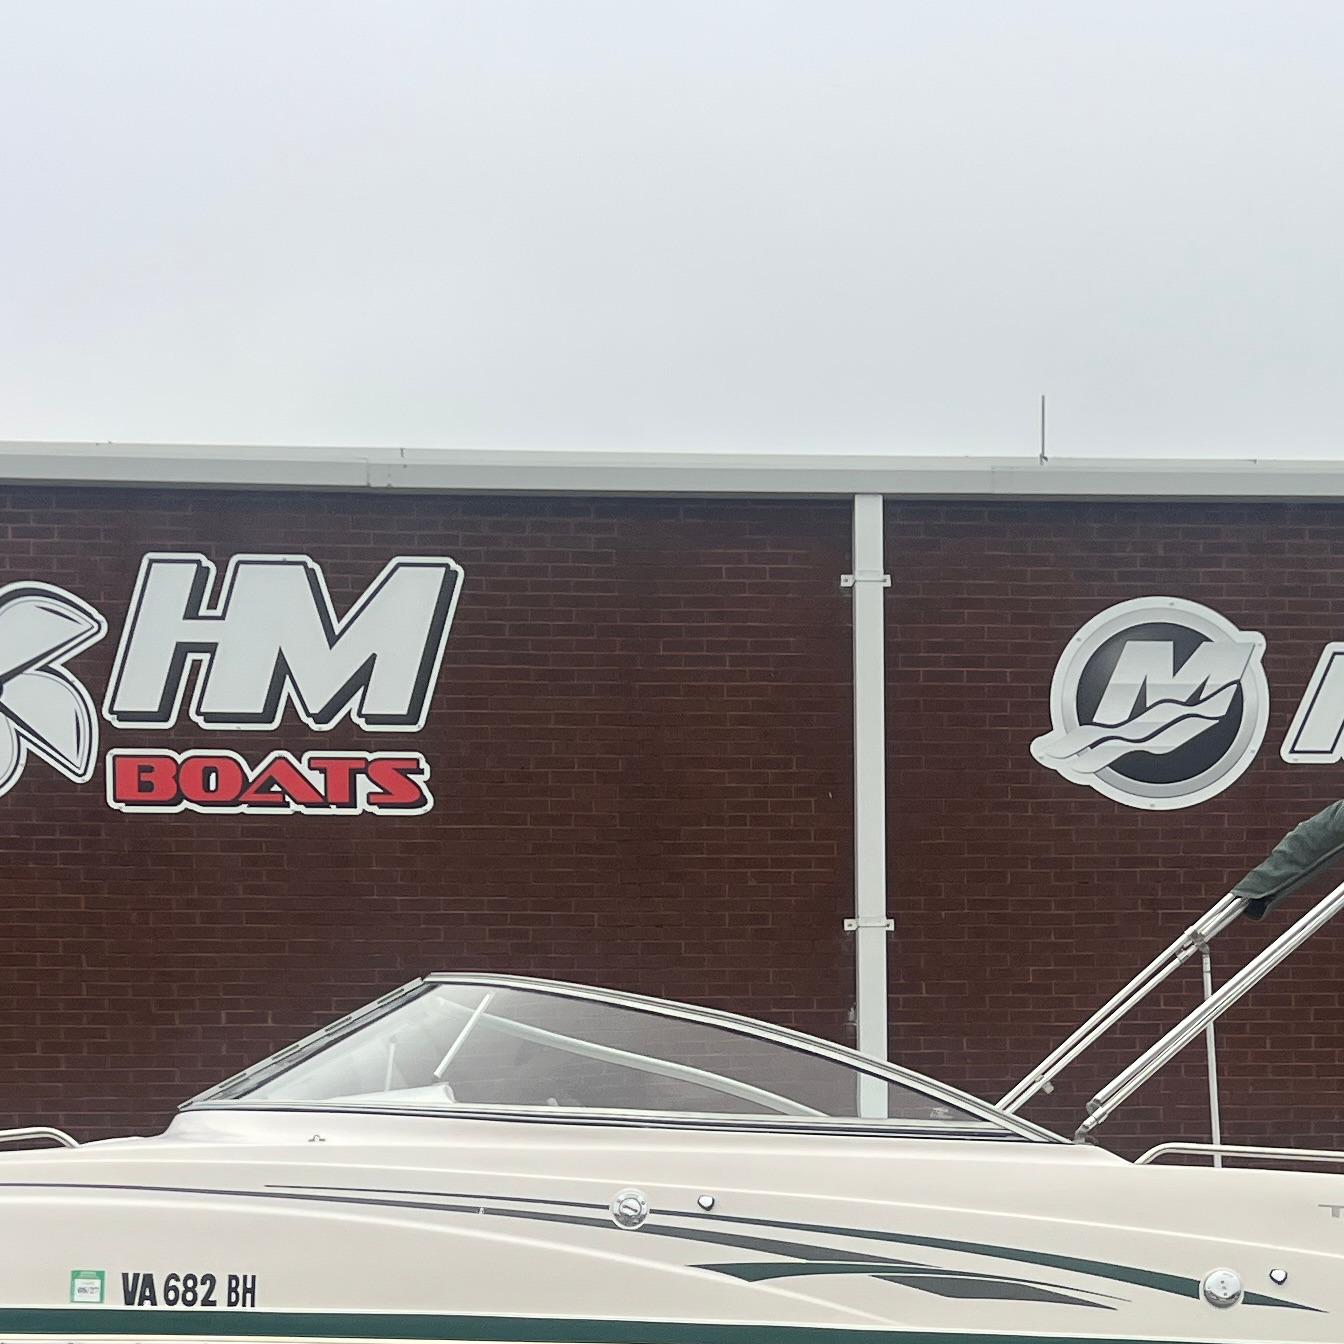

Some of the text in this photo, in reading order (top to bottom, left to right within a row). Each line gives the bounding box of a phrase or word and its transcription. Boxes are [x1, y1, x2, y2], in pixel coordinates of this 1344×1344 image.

[109, 555, 459, 727] HM
[113, 755, 427, 808] BOATS
[121, 1272, 257, 1308] VA 682 BH
